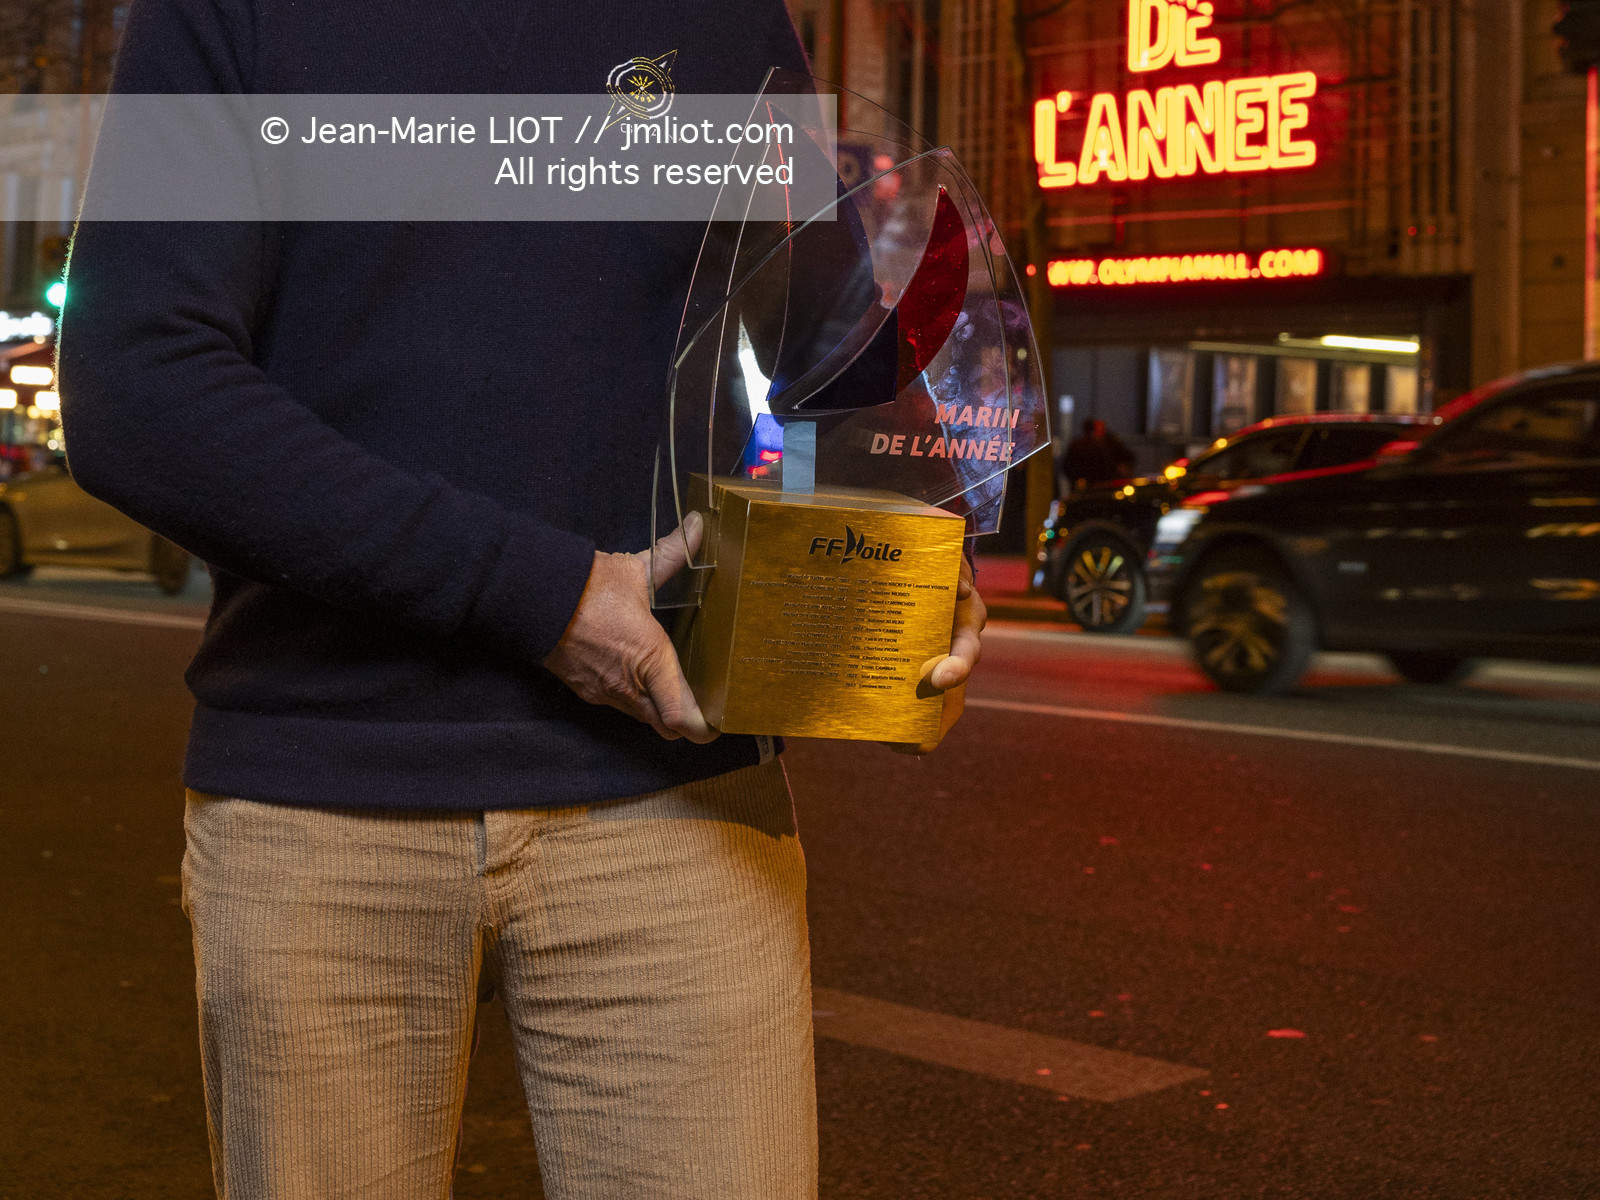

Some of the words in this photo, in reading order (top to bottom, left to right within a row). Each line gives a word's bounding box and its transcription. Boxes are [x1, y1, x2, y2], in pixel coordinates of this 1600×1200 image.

[1034, 71, 1317, 188] L'ANNEE
[934, 403, 1020, 429] MARIN
[870, 433, 906, 456] DE
[909, 435, 1016, 462] L'ANNÉE
